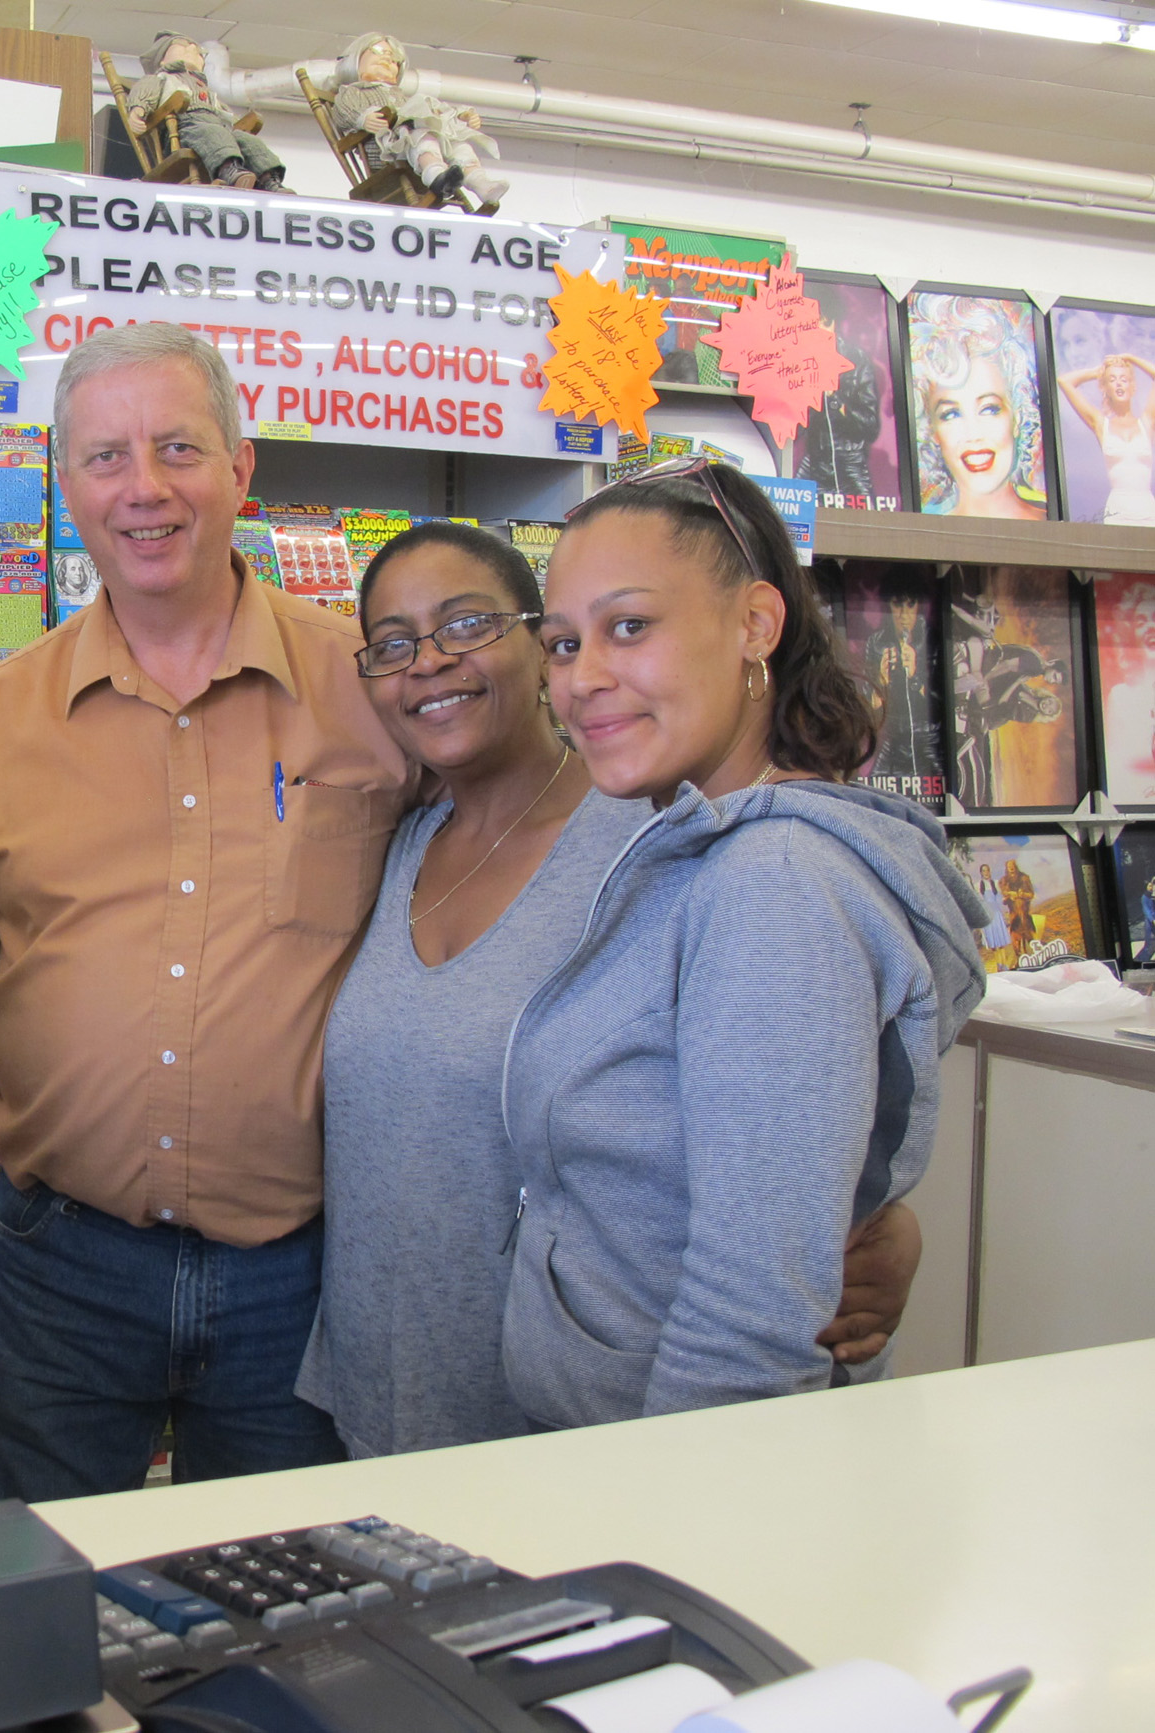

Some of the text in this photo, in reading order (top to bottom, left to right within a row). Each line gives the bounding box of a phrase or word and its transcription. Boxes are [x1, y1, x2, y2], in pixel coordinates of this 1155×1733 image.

[31, 192, 562, 272] REGARDLESS OF AGE
[36, 254, 237, 300] PLEASE
[256, 270, 400, 313] SHOW
[416, 284, 457, 318] ID
[626, 236, 769, 292] Newport
[589, 305, 639, 370] Must be
[625, 300, 649, 337] You
[333, 336, 509, 385] ALCOHOL
[521, 353, 543, 388] &
[562, 341, 621, 414] to purchase
[278, 384, 503, 438] PURCHASES
[657, 439, 686, 455] 777
[305, 505, 330, 514] X25
[774, 487, 812, 502] WAYS
[351, 532, 399, 543] MAYHE
[512, 526, 562, 544] $5,000,00
[330, 600, 355, 615] X25
